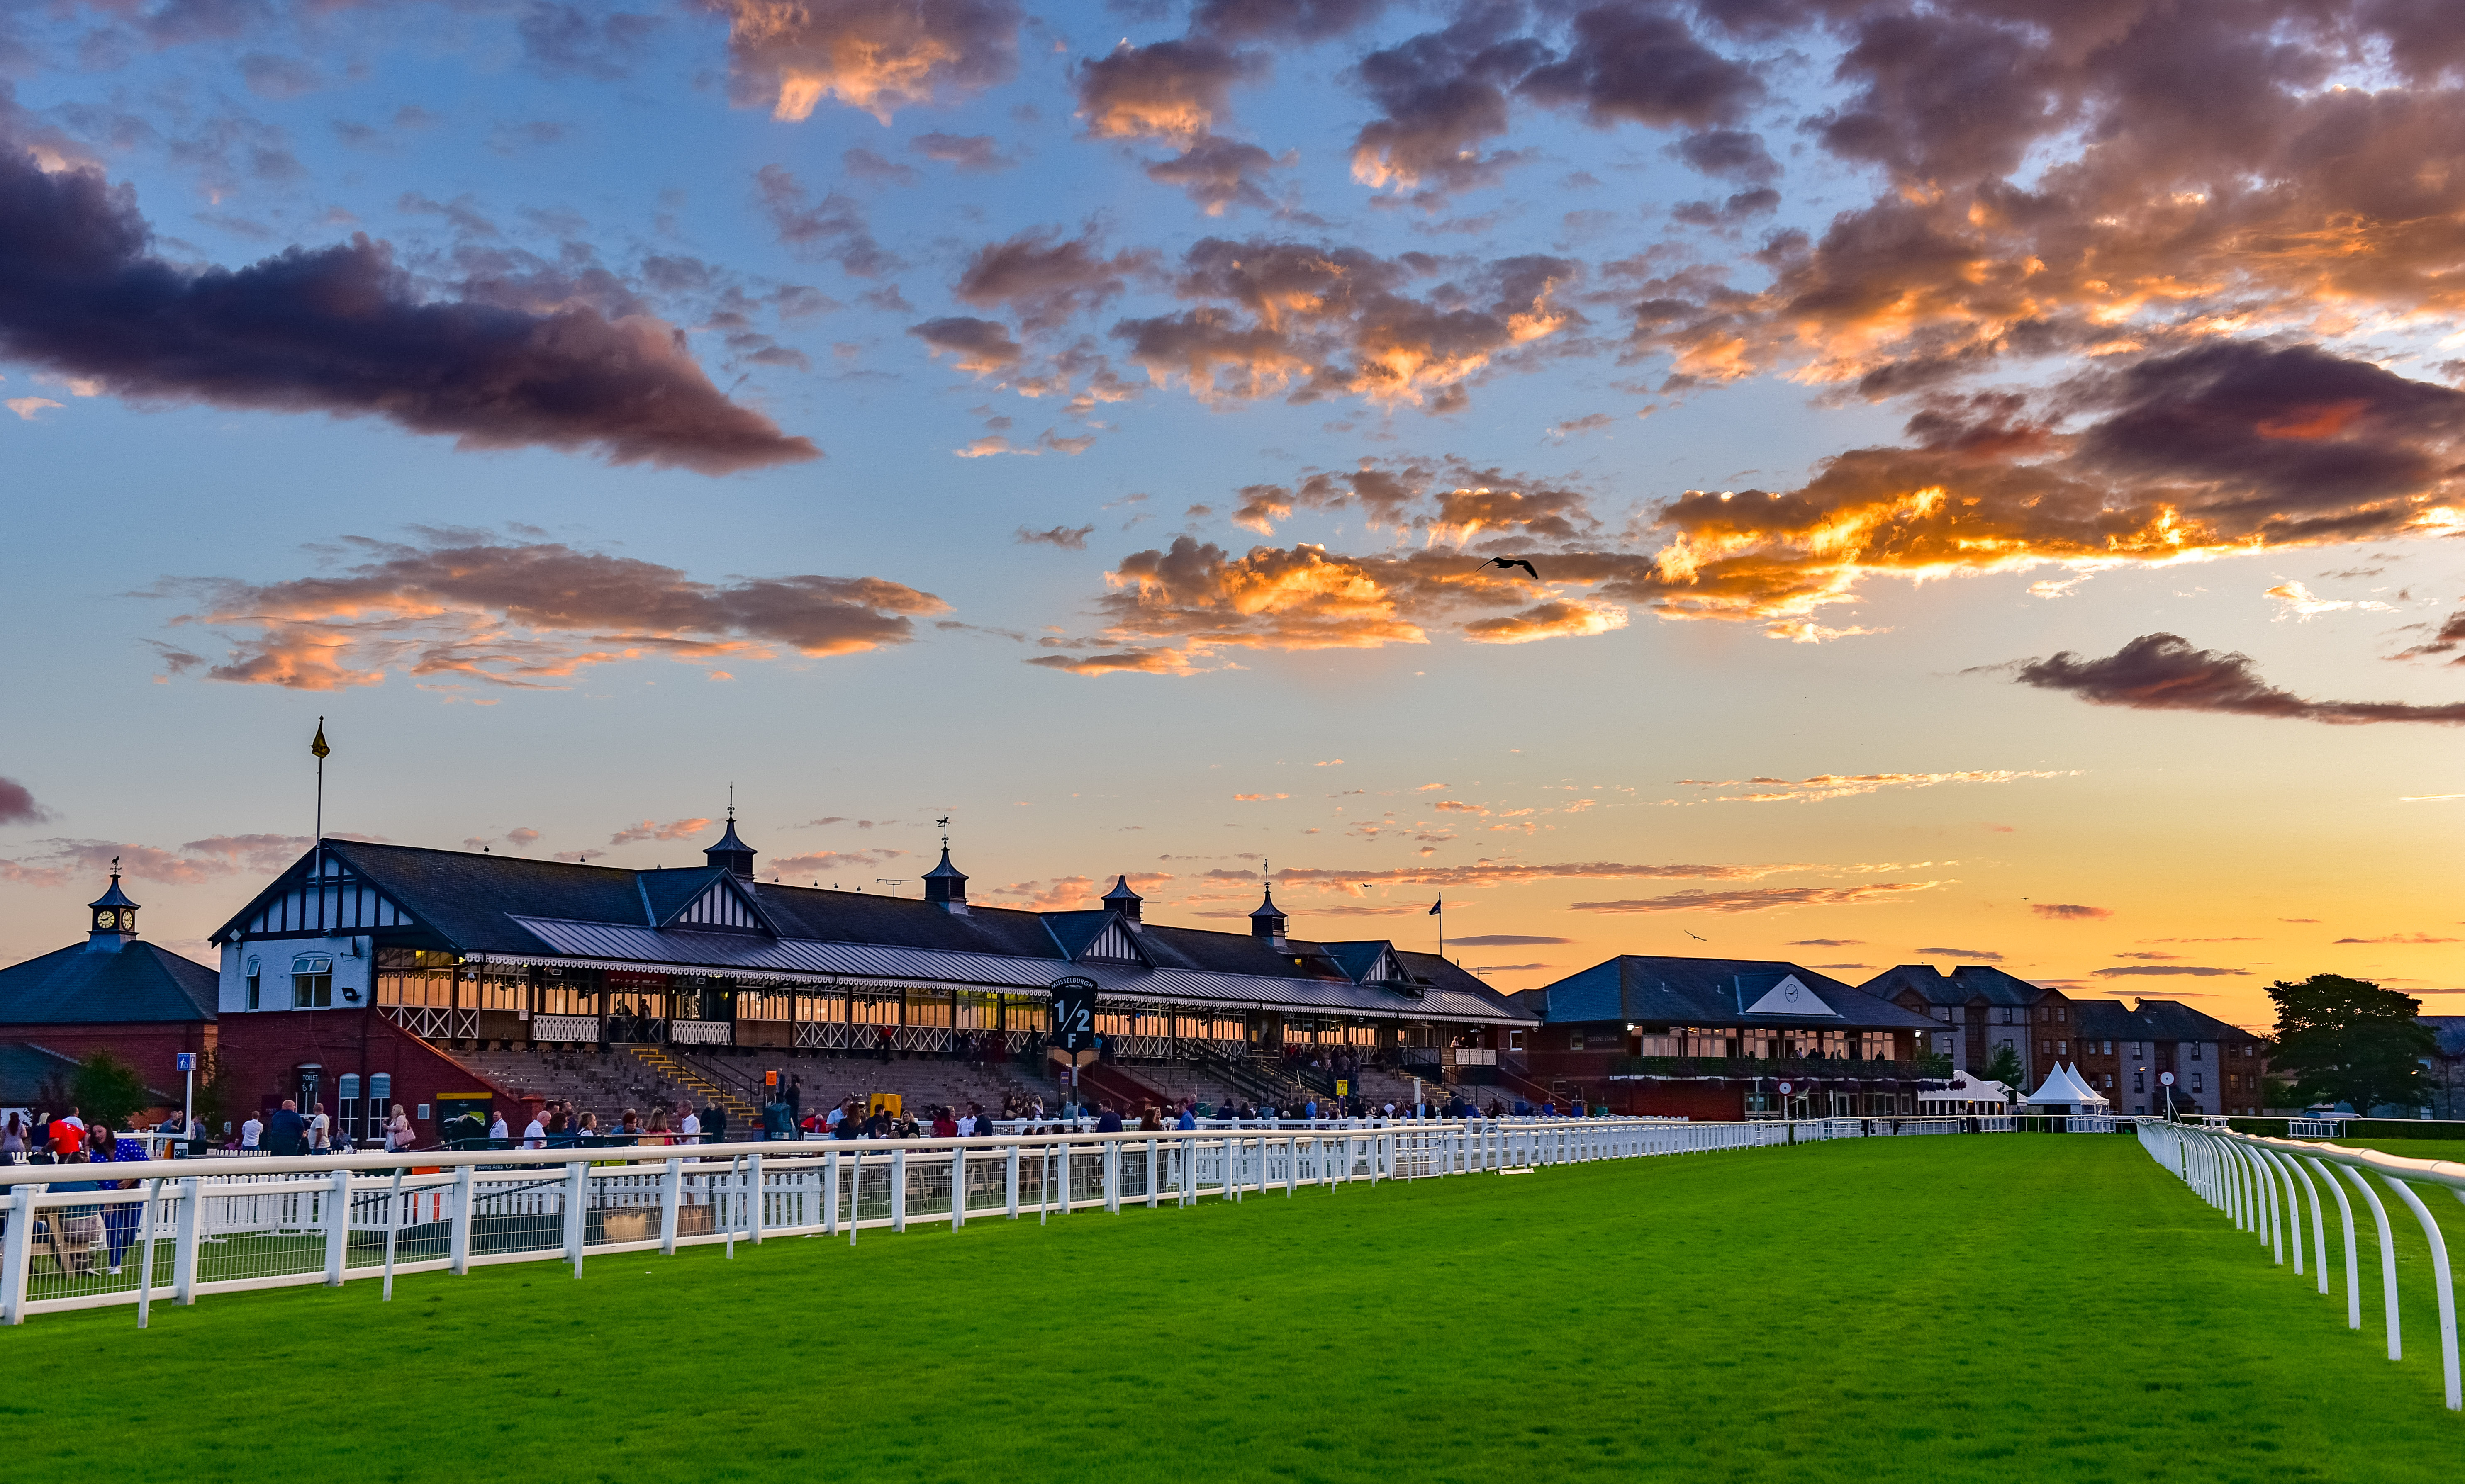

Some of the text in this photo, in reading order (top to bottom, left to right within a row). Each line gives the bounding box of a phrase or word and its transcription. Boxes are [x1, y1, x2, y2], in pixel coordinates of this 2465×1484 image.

[1051, 978, 1094, 989] MUSSELBURGH
[1055, 1000, 1090, 1032] 1/2
[1068, 1033, 1076, 1048] F
